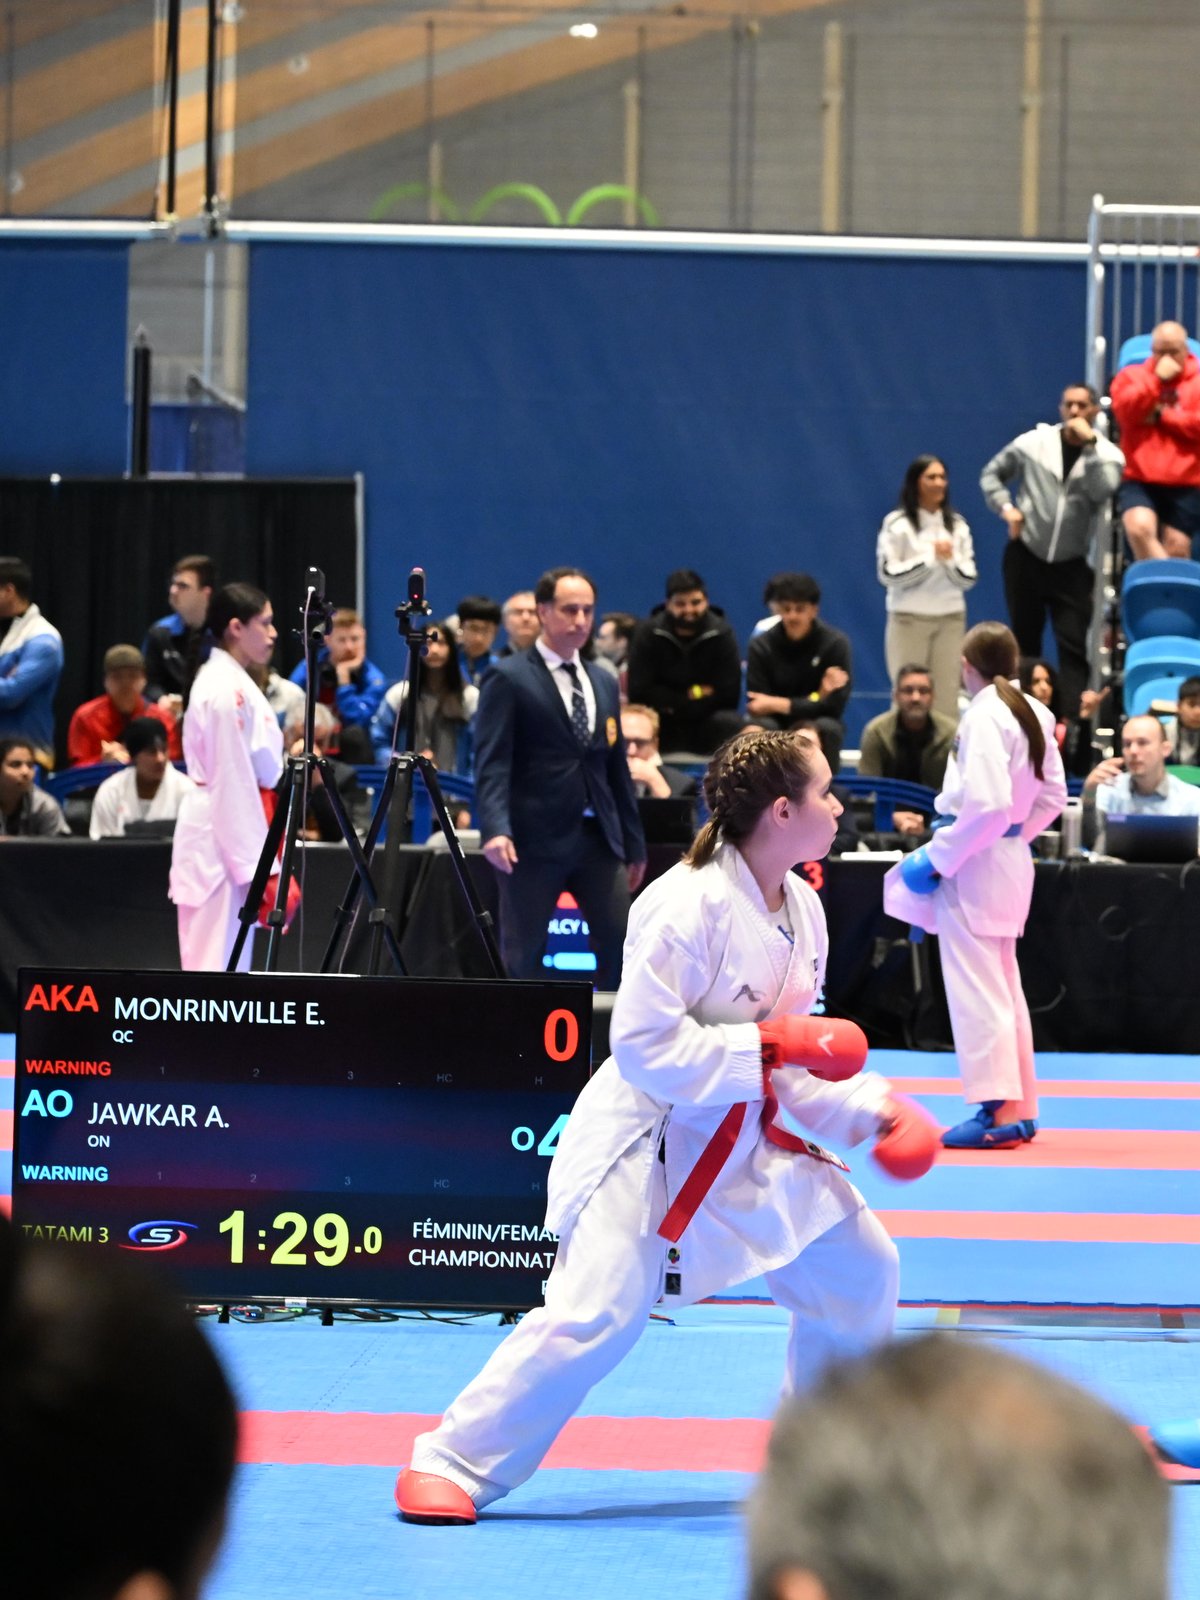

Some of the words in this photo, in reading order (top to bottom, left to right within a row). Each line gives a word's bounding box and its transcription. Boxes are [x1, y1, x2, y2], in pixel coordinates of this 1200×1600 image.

[24, 984, 99, 1013] AKA
[114, 996, 297, 1025] MONRINVILLE
[305, 1002, 326, 1025] E.
[112, 1030, 134, 1044] QC
[544, 1008, 579, 1062] 0
[25, 1059, 112, 1077] WARNING
[253, 1068, 260, 1078] 2
[348, 1070, 354, 1080] 3
[436, 1073, 453, 1083] HC
[535, 1076, 543, 1086] H
[21, 1089, 74, 1118] AO
[87, 1102, 198, 1128] JAWKAR
[204, 1105, 230, 1128] A.
[87, 1135, 111, 1148] ON
[22, 1165, 109, 1183] WARNING
[250, 1174, 257, 1184] 2
[344, 1176, 351, 1186] 3
[433, 1179, 450, 1189] HC
[531, 1182, 540, 1192] H
[22, 1224, 93, 1243] TATAMI
[98, 1227, 109, 1244] 3
[408, 1249, 555, 1269] CHAMPIONNAT
